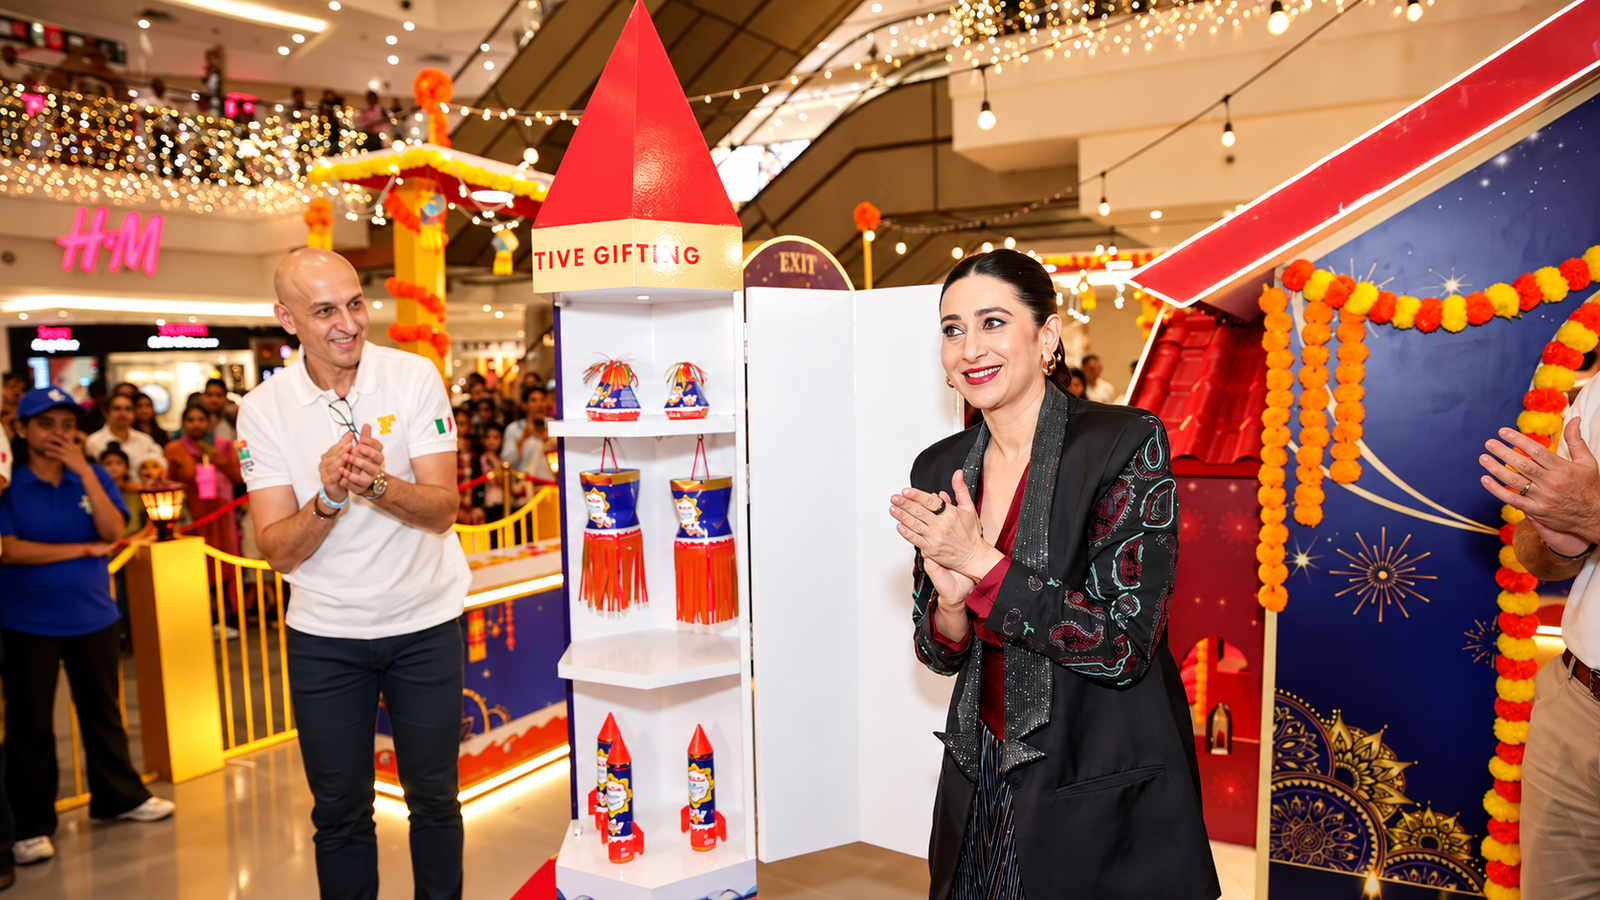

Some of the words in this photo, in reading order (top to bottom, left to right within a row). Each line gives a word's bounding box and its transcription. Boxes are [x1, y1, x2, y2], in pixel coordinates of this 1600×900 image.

[534, 248, 585, 270] TIVE
[593, 243, 700, 265] GIFTING
[779, 251, 817, 275] EXIT
